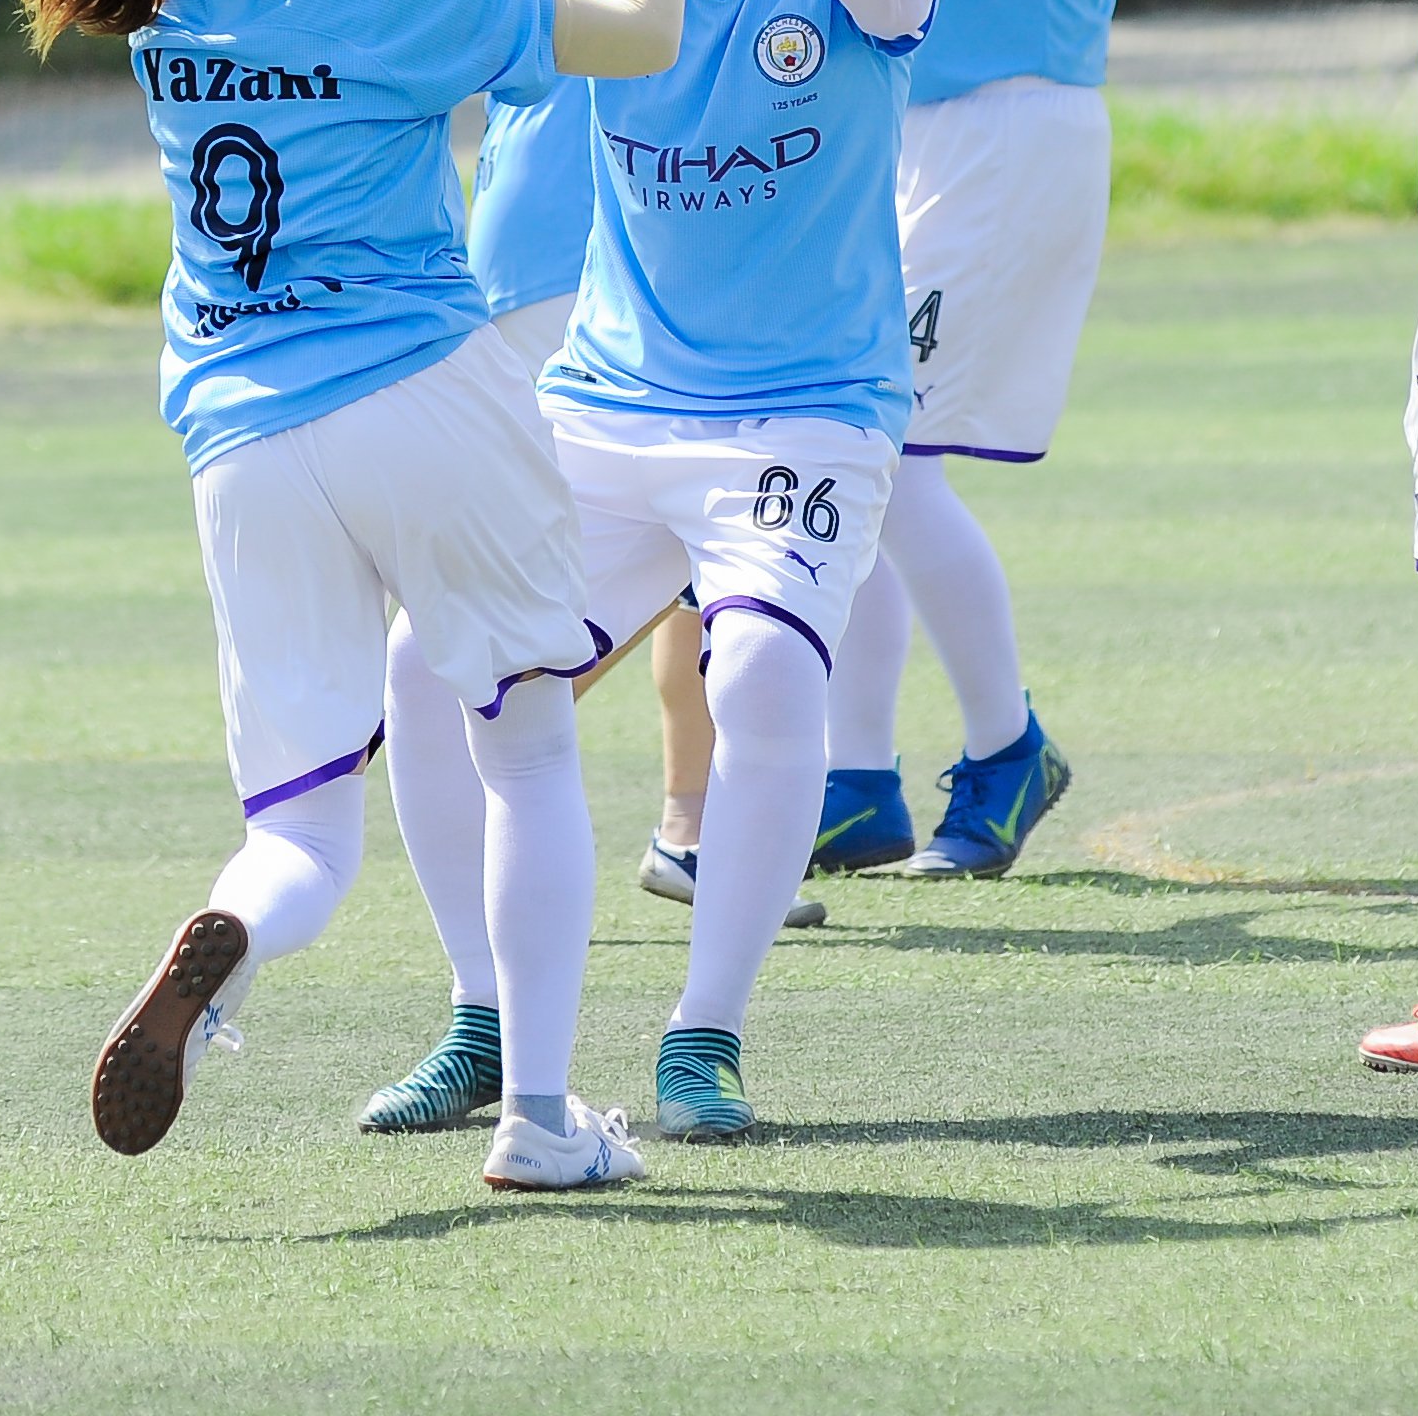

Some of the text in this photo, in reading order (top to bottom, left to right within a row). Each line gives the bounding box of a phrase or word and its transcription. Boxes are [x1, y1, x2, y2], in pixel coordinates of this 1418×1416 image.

[759, 17, 815, 45] MANCHESTER
[781, 72, 803, 82] CITY
[771, 92, 818, 111] 125 YEARS
[189, 122, 285, 293] 9
[629, 180, 778, 212] IRWAYS
[908, 290, 942, 362] 4
[752, 465, 840, 543] 86
